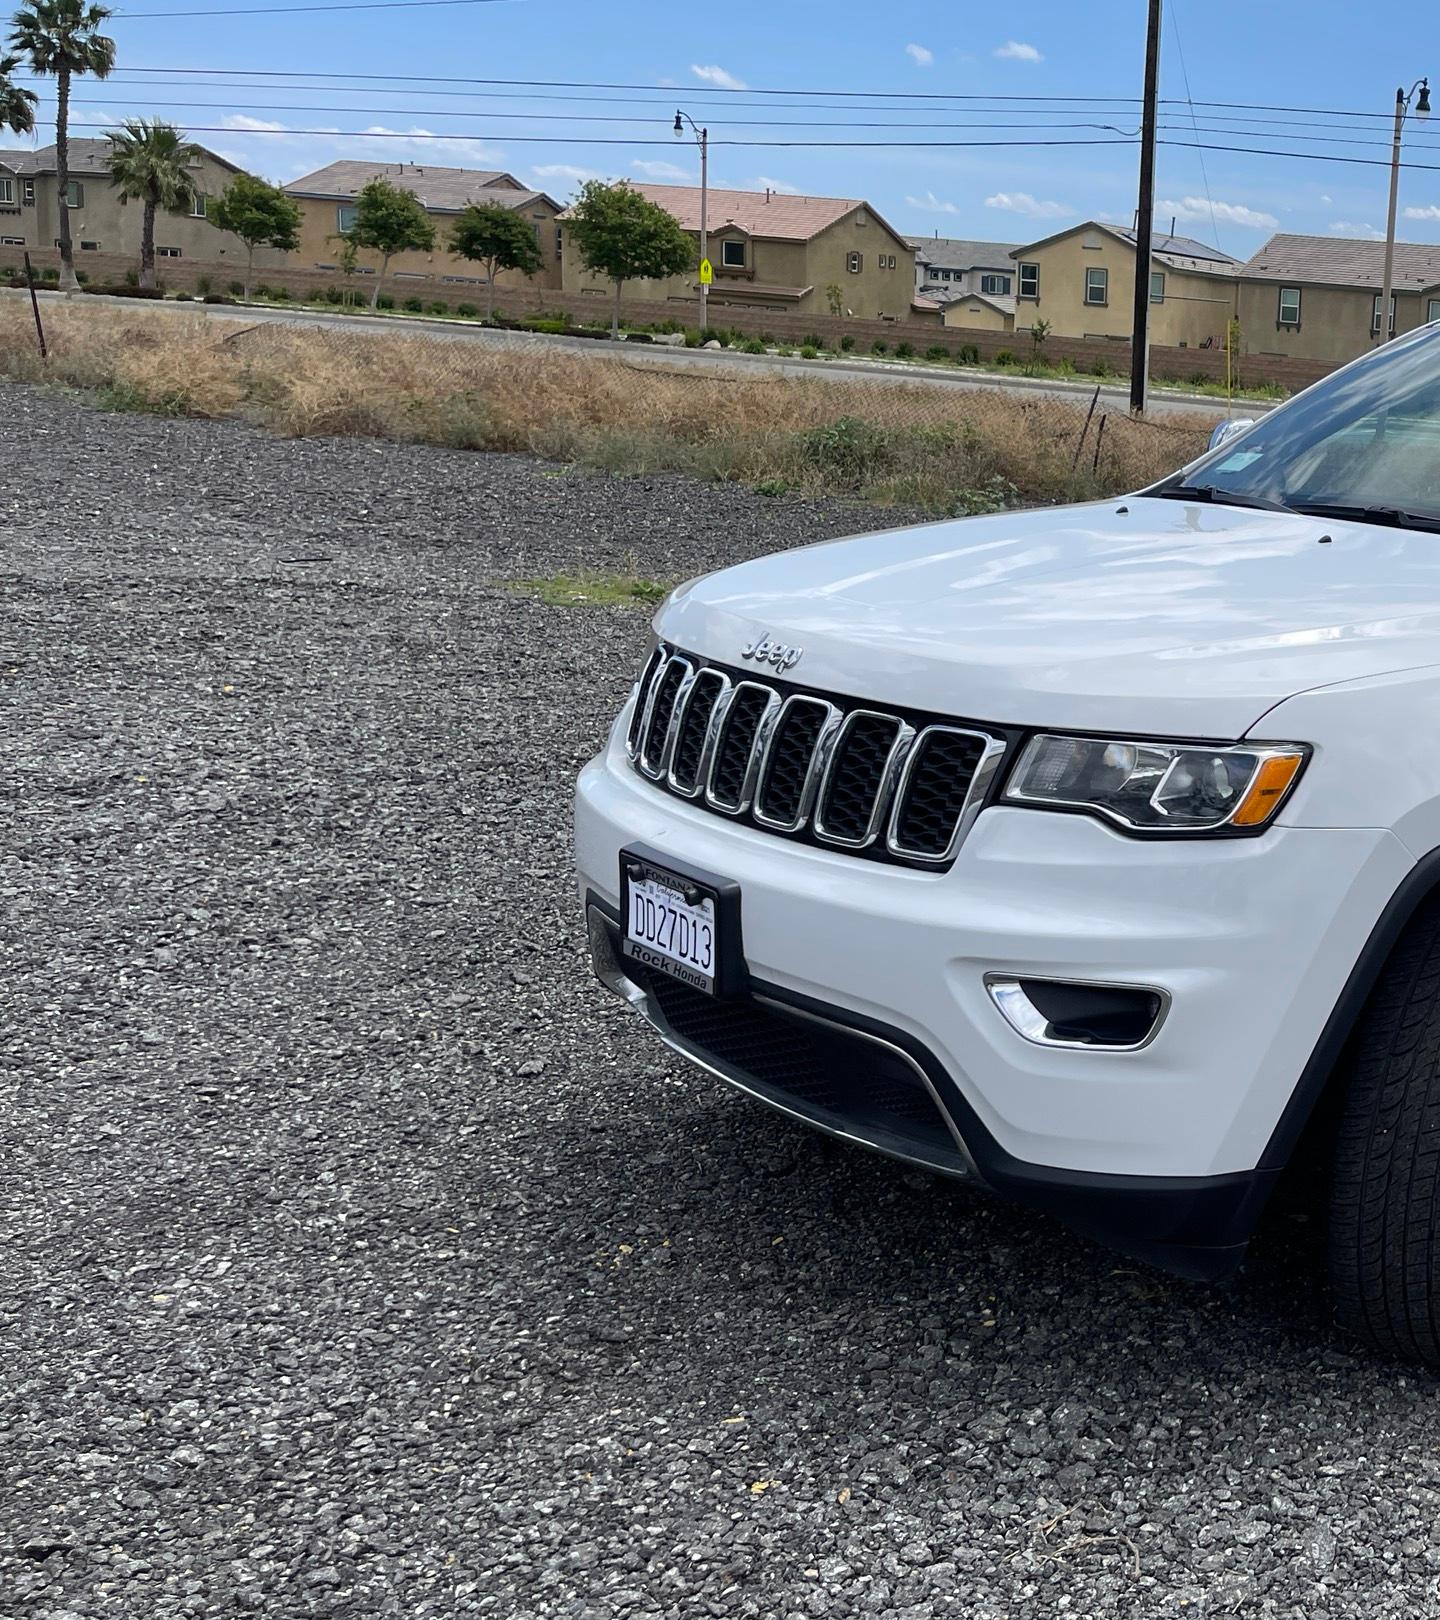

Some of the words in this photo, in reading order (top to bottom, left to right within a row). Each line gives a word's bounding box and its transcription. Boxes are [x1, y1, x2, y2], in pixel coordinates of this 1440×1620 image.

[741, 631, 803, 674] Jeep
[635, 893, 711, 970] DD27D13
[631, 944, 670, 971] Rock
[673, 964, 707, 989] Honda
